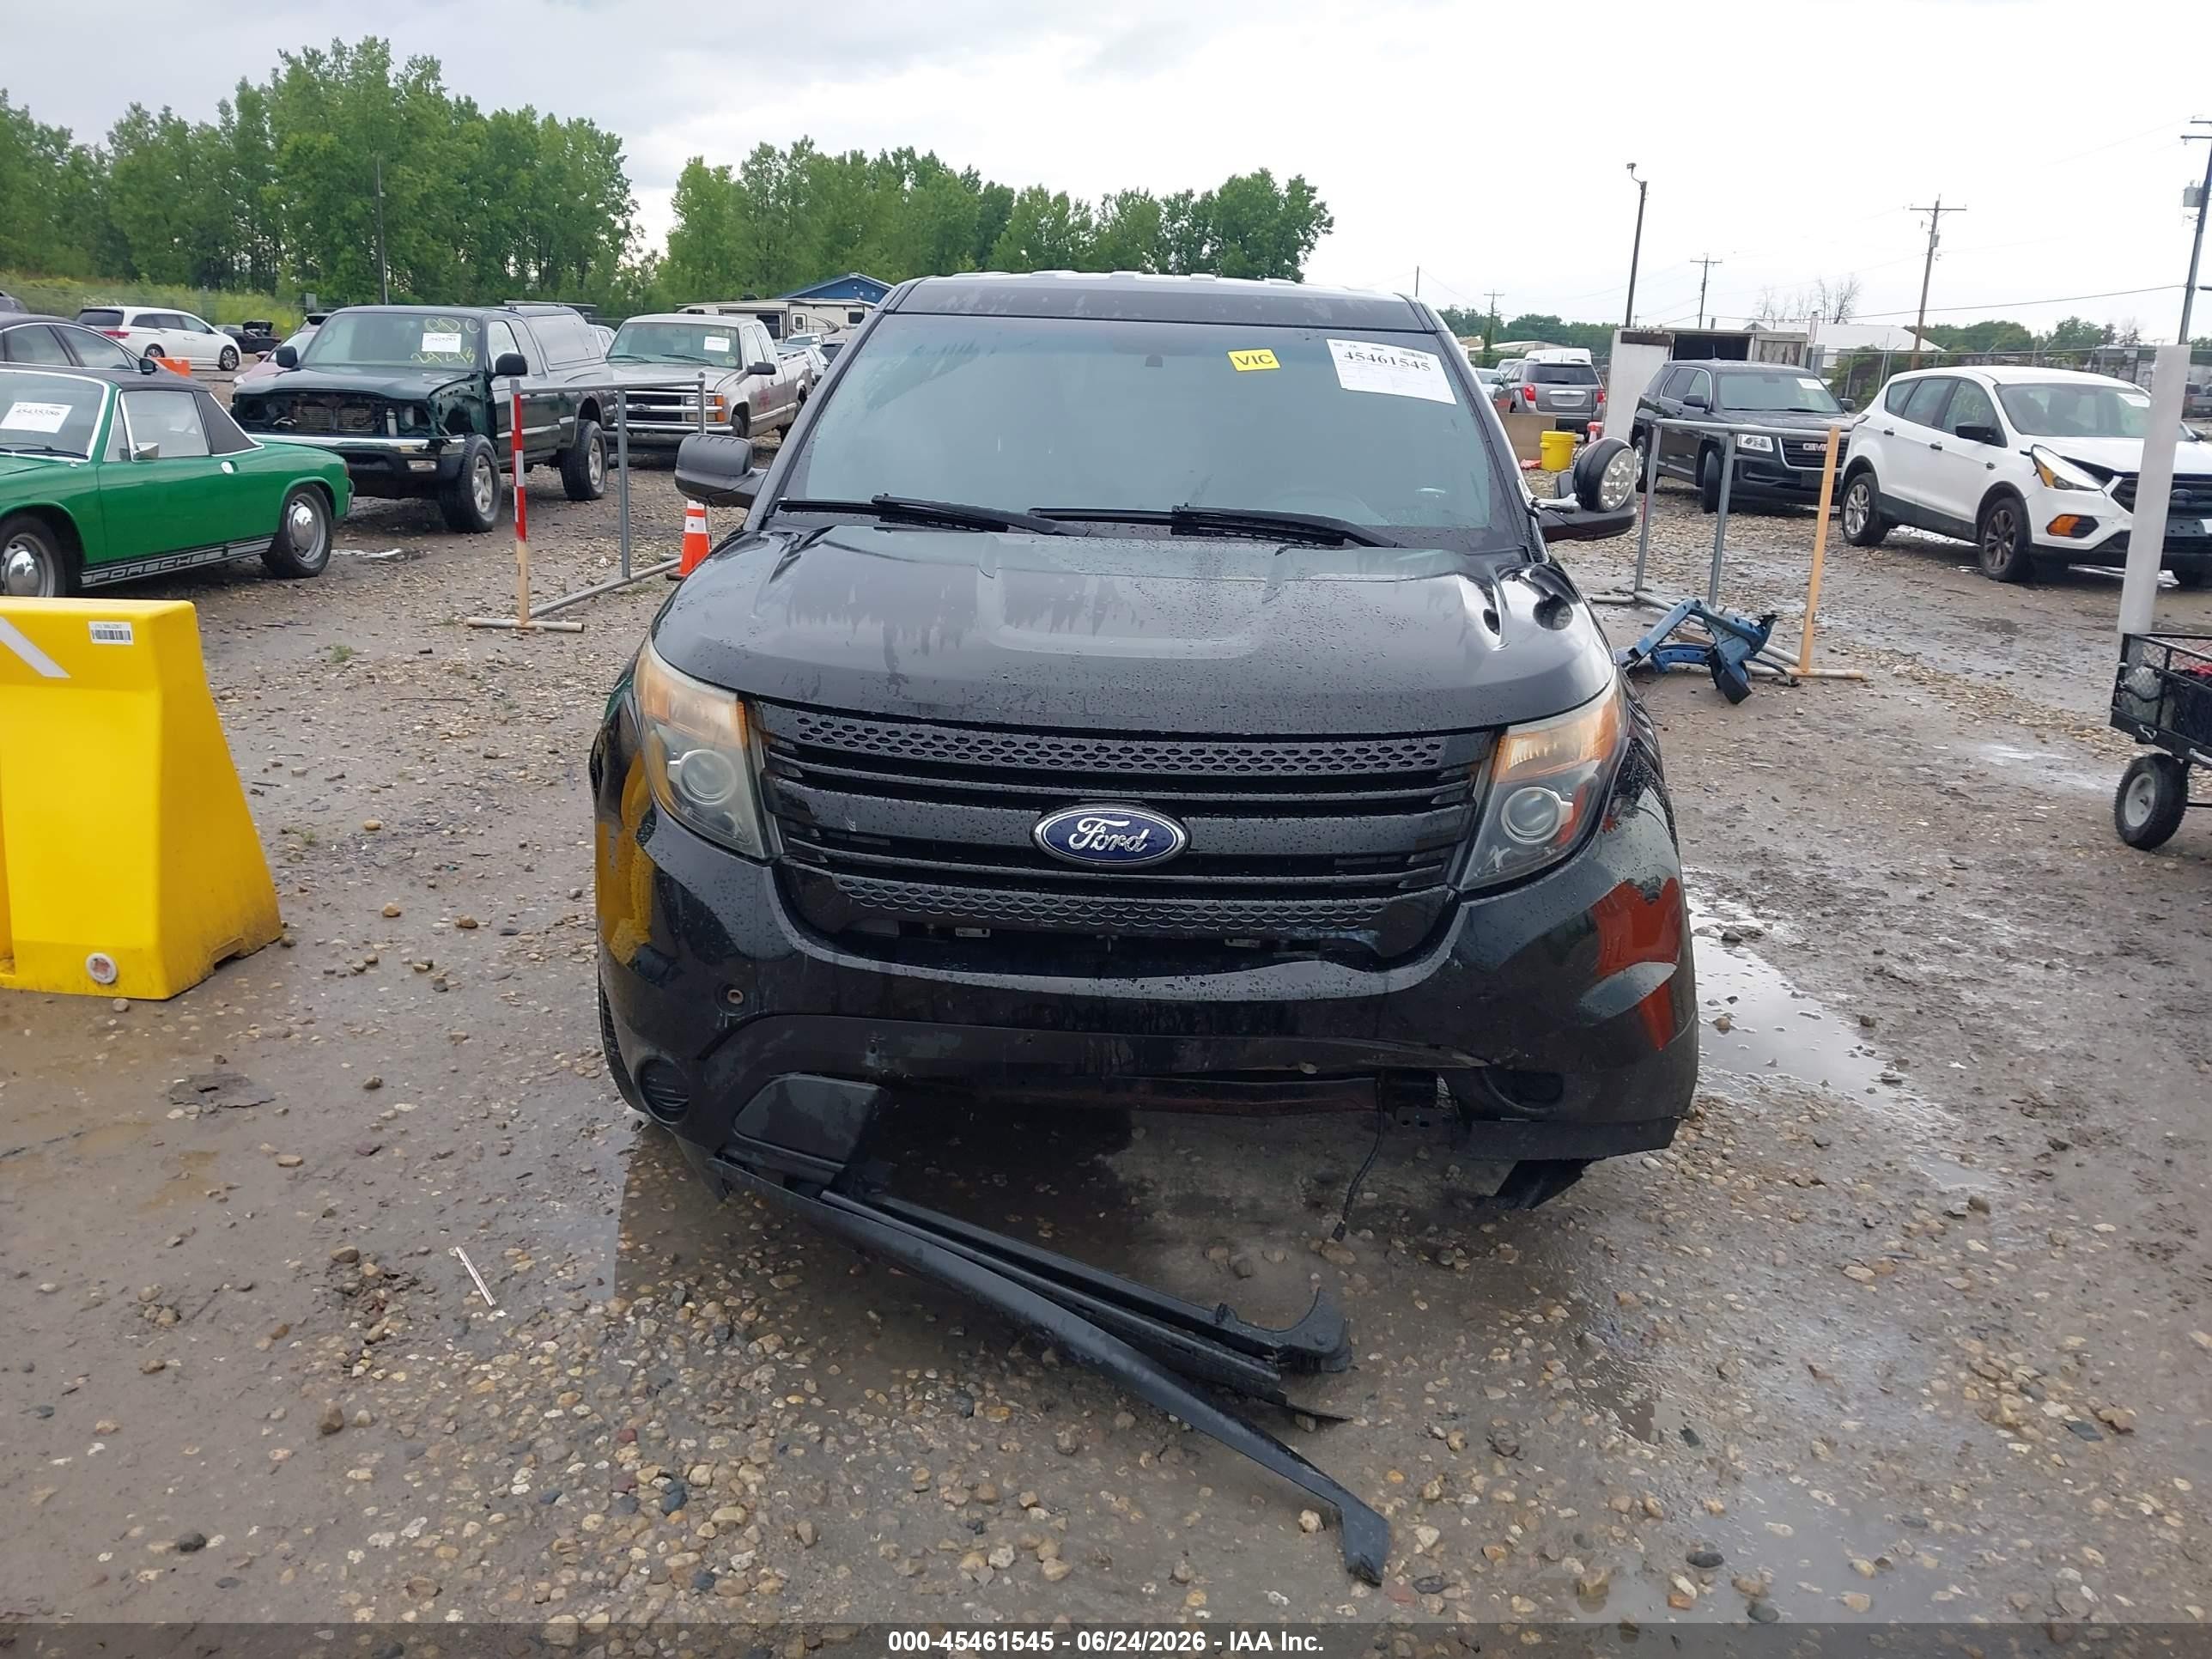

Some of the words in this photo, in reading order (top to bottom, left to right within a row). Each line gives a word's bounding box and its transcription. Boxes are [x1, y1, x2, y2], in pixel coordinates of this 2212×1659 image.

[1234, 354, 1273, 366] VIC
[1344, 351, 1431, 372] 45461545
[1802, 442, 1827, 452] GM
[92, 551, 207, 583] PORSCHE
[1068, 817, 1151, 853] Ford
